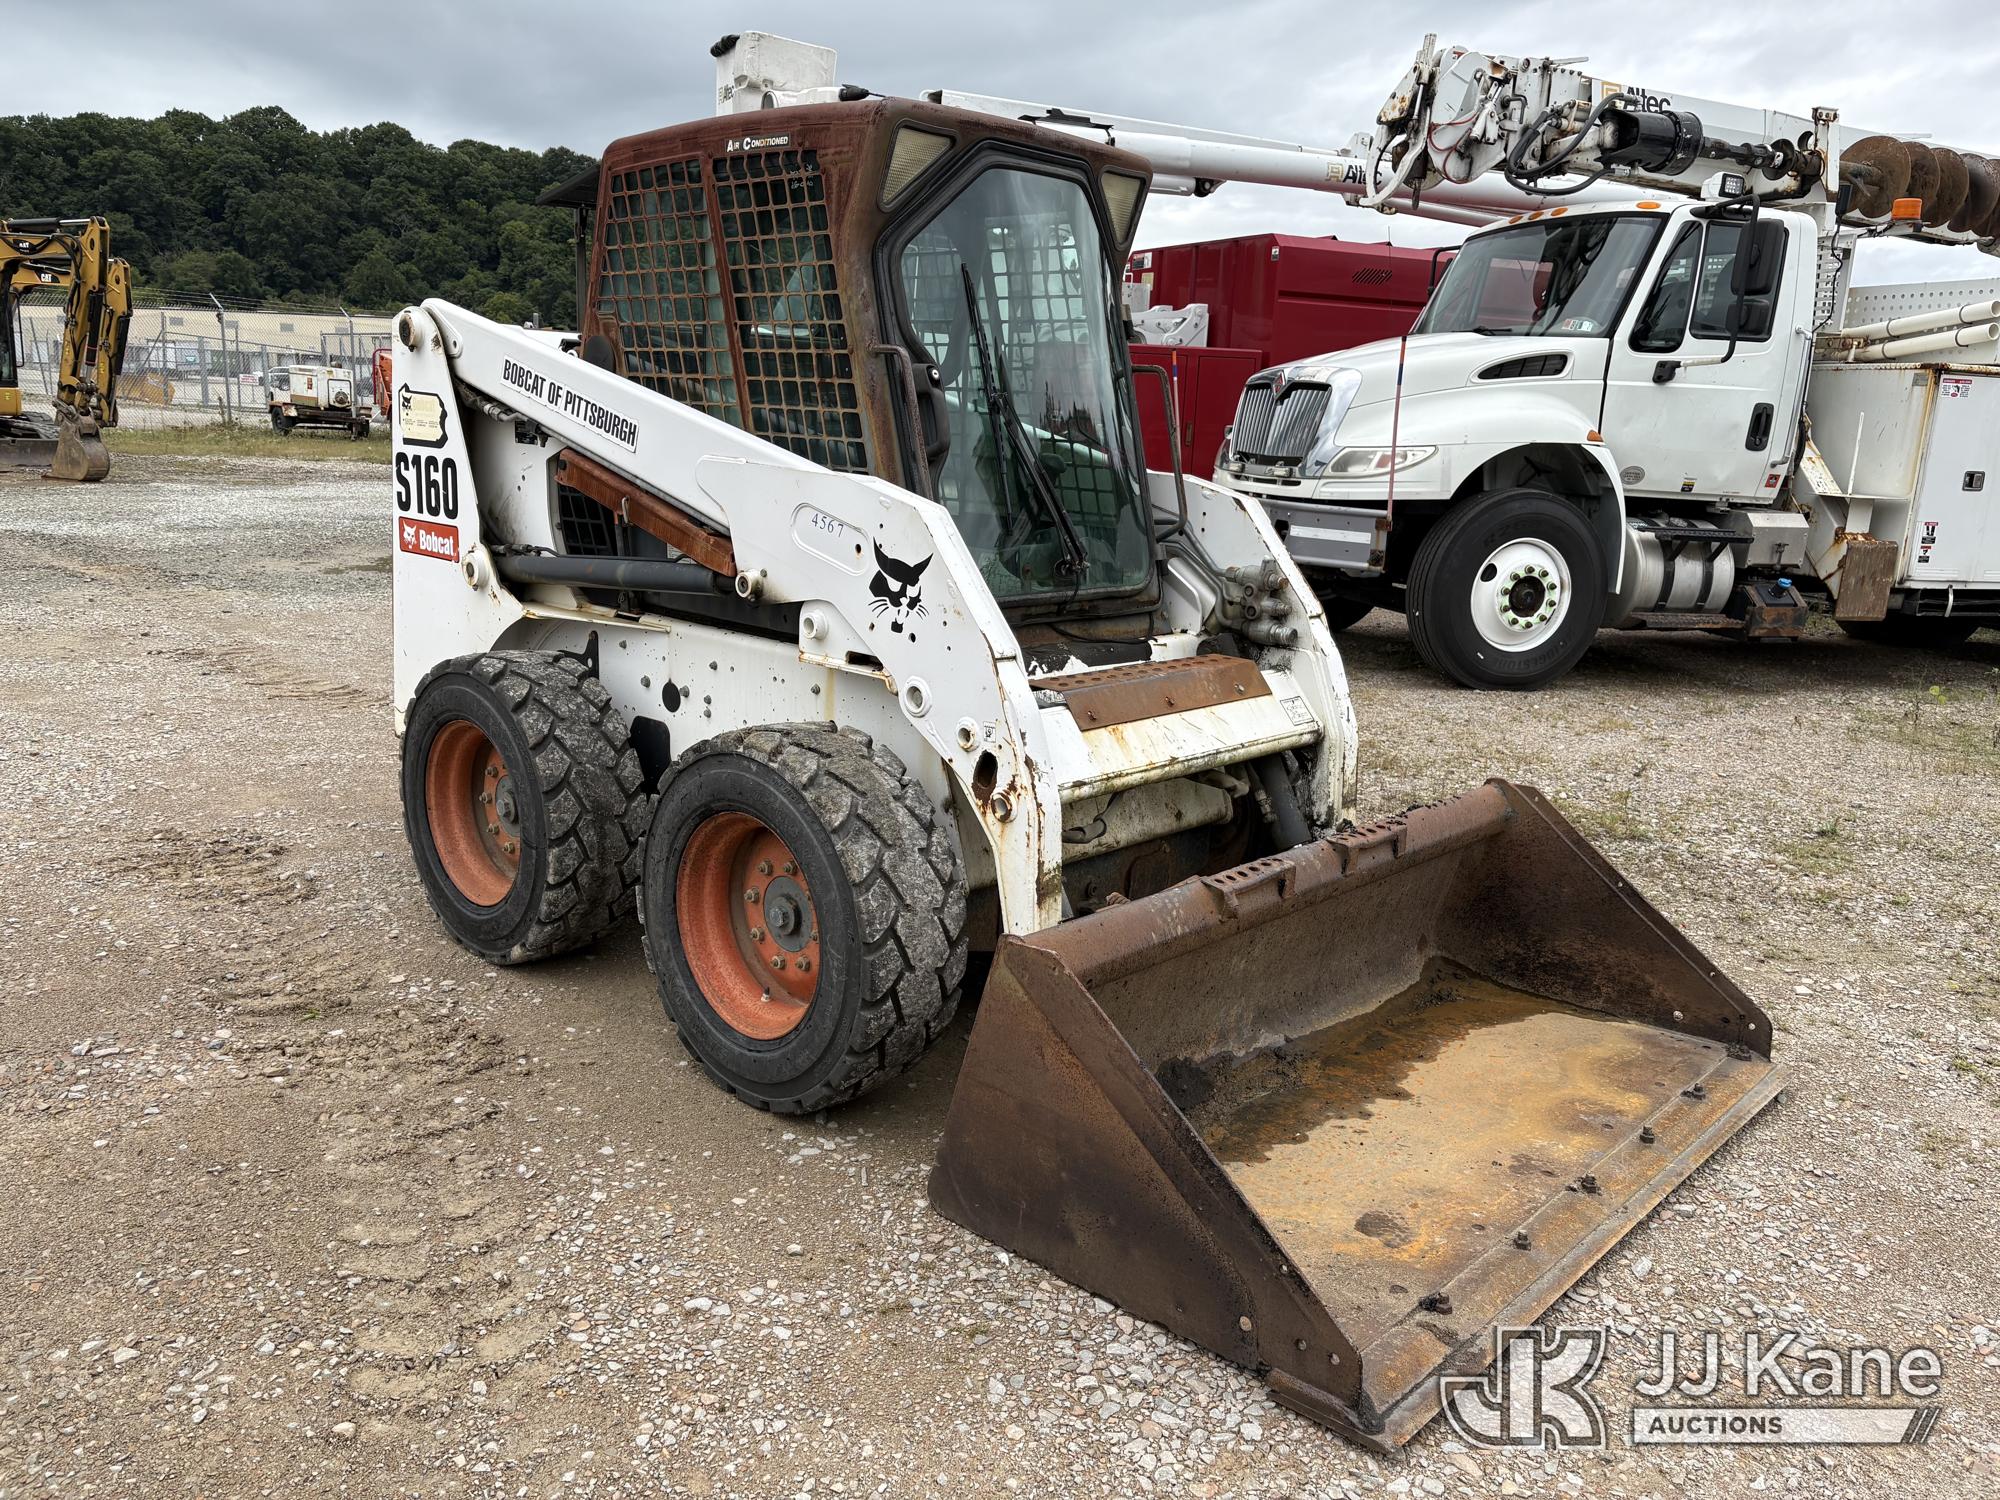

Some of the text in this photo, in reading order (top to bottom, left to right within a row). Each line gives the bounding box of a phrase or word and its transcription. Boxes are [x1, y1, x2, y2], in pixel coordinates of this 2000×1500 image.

[1342, 164, 1382, 186] Altc
[41, 273, 52, 282] CAT
[503, 359, 637, 447] BOBCAT OF PITTSBURGH
[395, 452, 459, 519] S160
[811, 513, 844, 537] 4567
[419, 529, 455, 557] Bobcat
